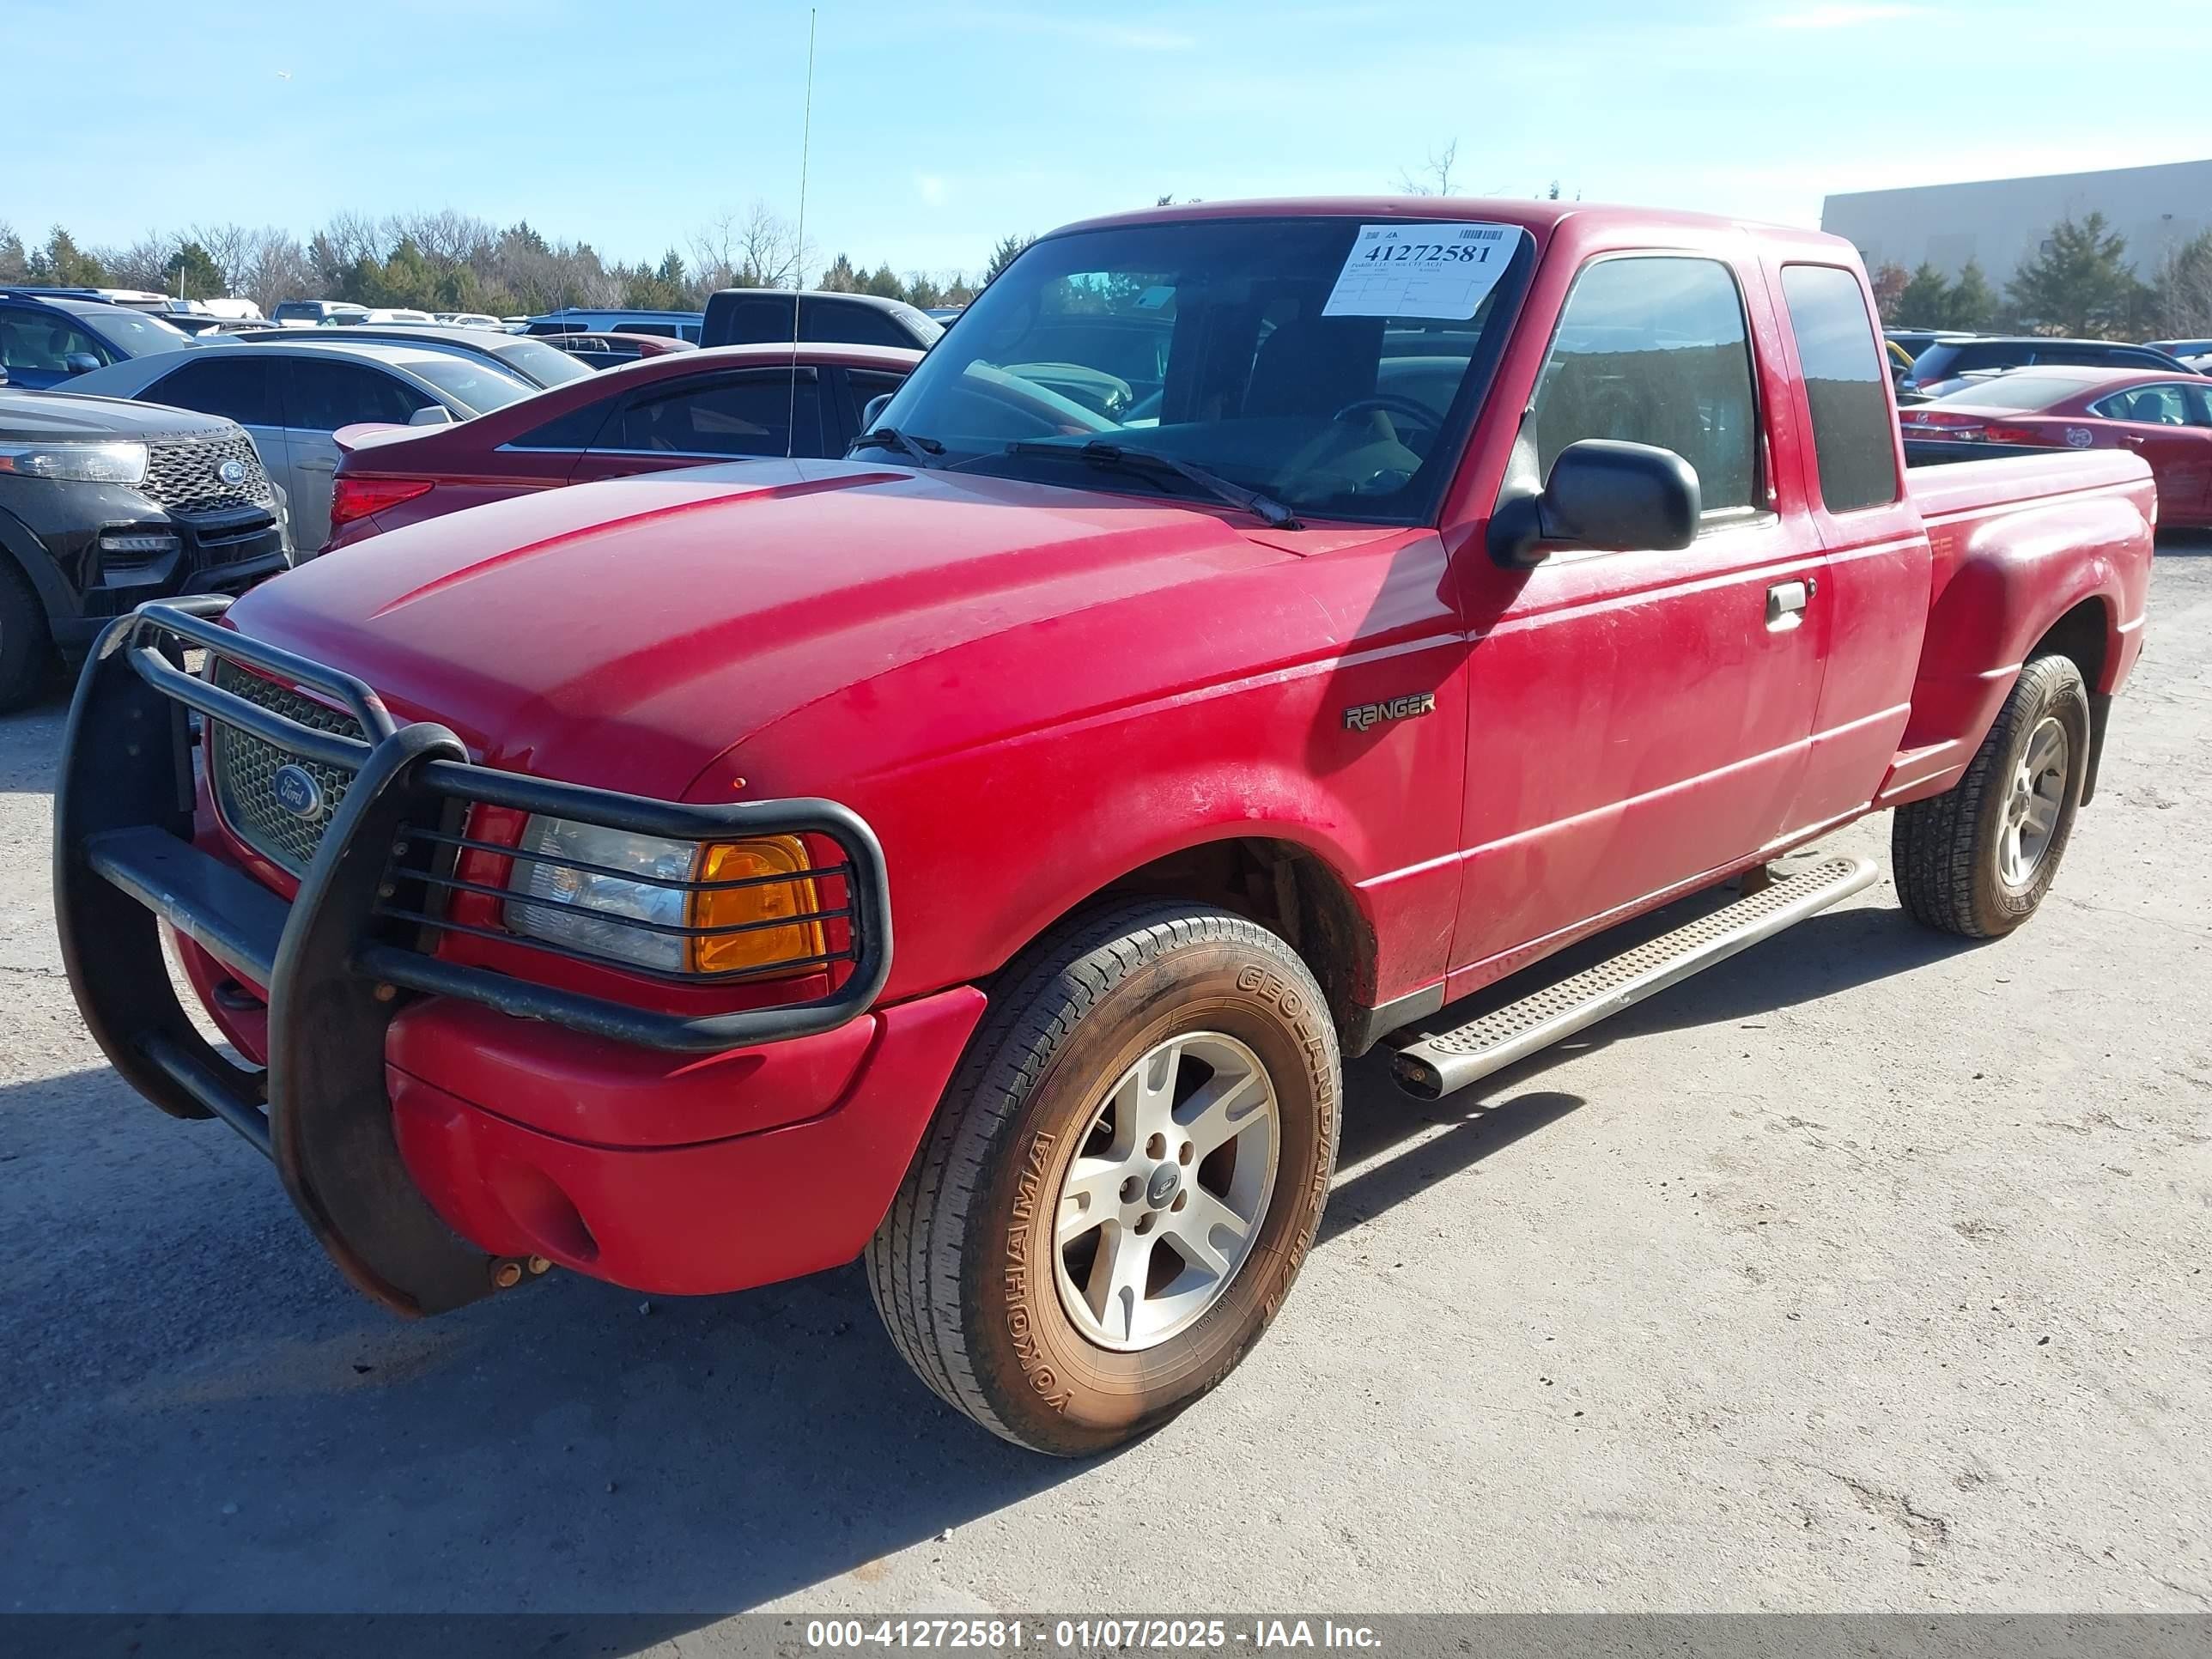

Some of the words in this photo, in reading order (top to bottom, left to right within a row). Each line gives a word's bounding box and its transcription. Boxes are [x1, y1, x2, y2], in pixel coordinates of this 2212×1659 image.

[1364, 245, 1491, 263] 41272581
[281, 775, 304, 805] Ford
[1006, 1131, 1074, 1414] YOKOHAMA
